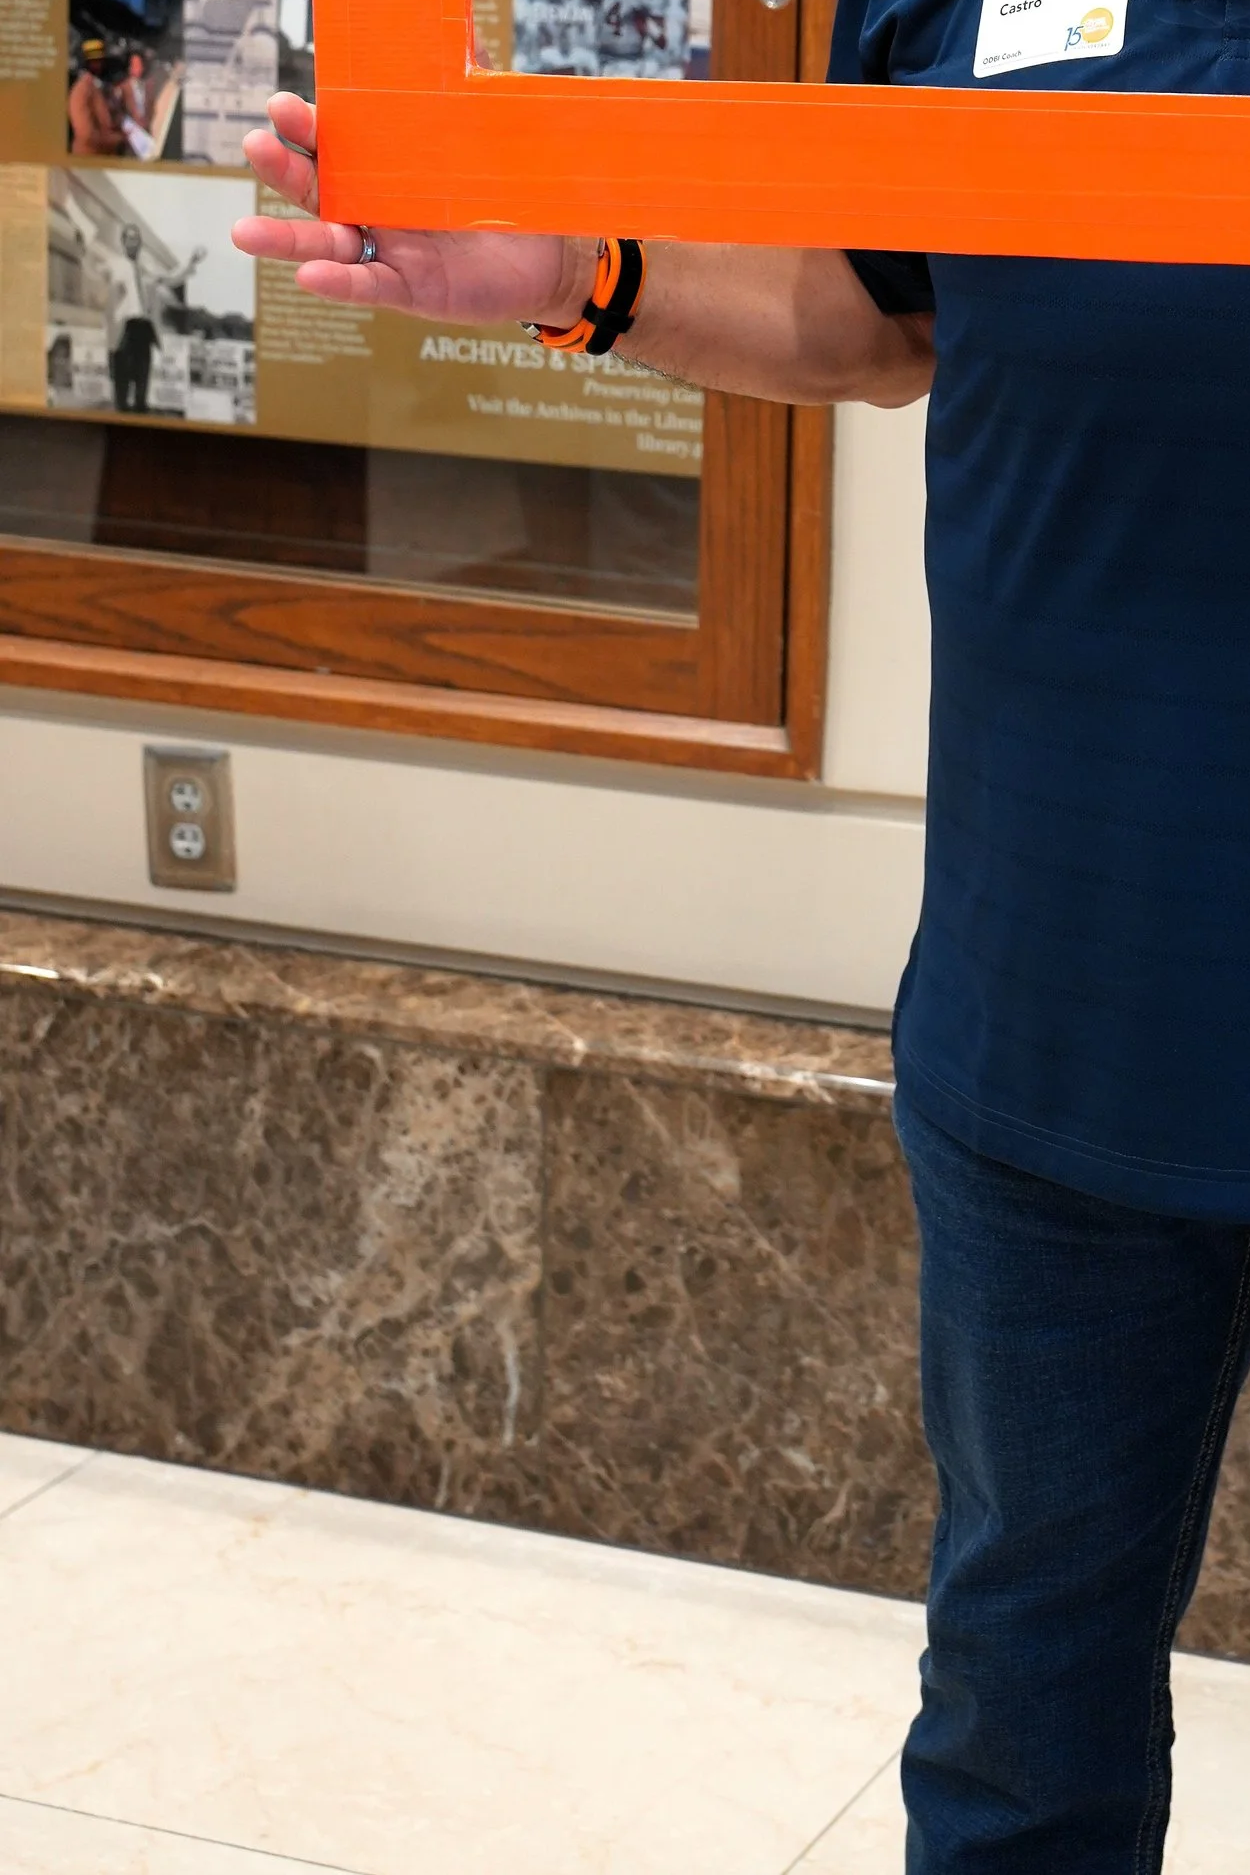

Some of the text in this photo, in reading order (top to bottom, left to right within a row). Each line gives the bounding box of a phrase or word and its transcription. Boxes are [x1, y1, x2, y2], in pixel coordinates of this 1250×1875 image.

[1000, 0, 1042, 16] Castro
[1064, 26, 1084, 52] 15
[420, 335, 545, 370] ARCHIVES
[506, 397, 533, 418] the
[624, 408, 652, 428] the
